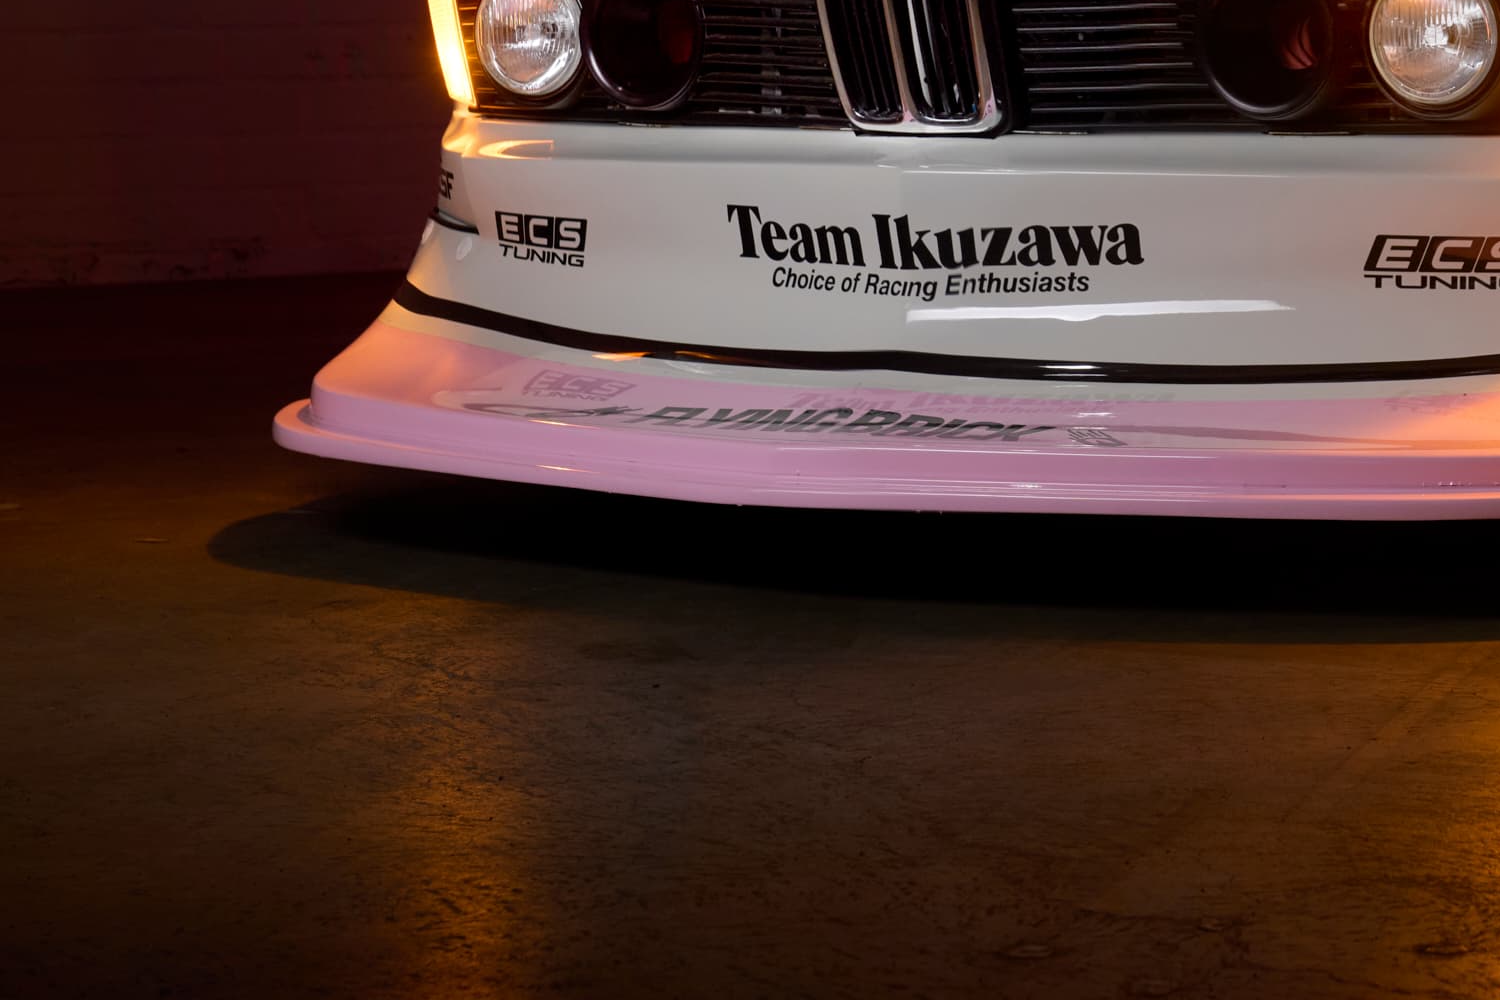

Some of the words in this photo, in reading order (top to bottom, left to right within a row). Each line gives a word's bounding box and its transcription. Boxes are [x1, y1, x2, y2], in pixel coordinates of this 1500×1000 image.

[495, 210, 588, 252] ECS
[727, 203, 866, 267] Team
[871, 213, 1144, 270] Ikuzawa
[498, 243, 585, 268] TUNING
[772, 266, 836, 292] Choice
[841, 272, 861, 293] of
[865, 273, 938, 302] Racing
[945, 272, 1090, 296] Enthusiasts
